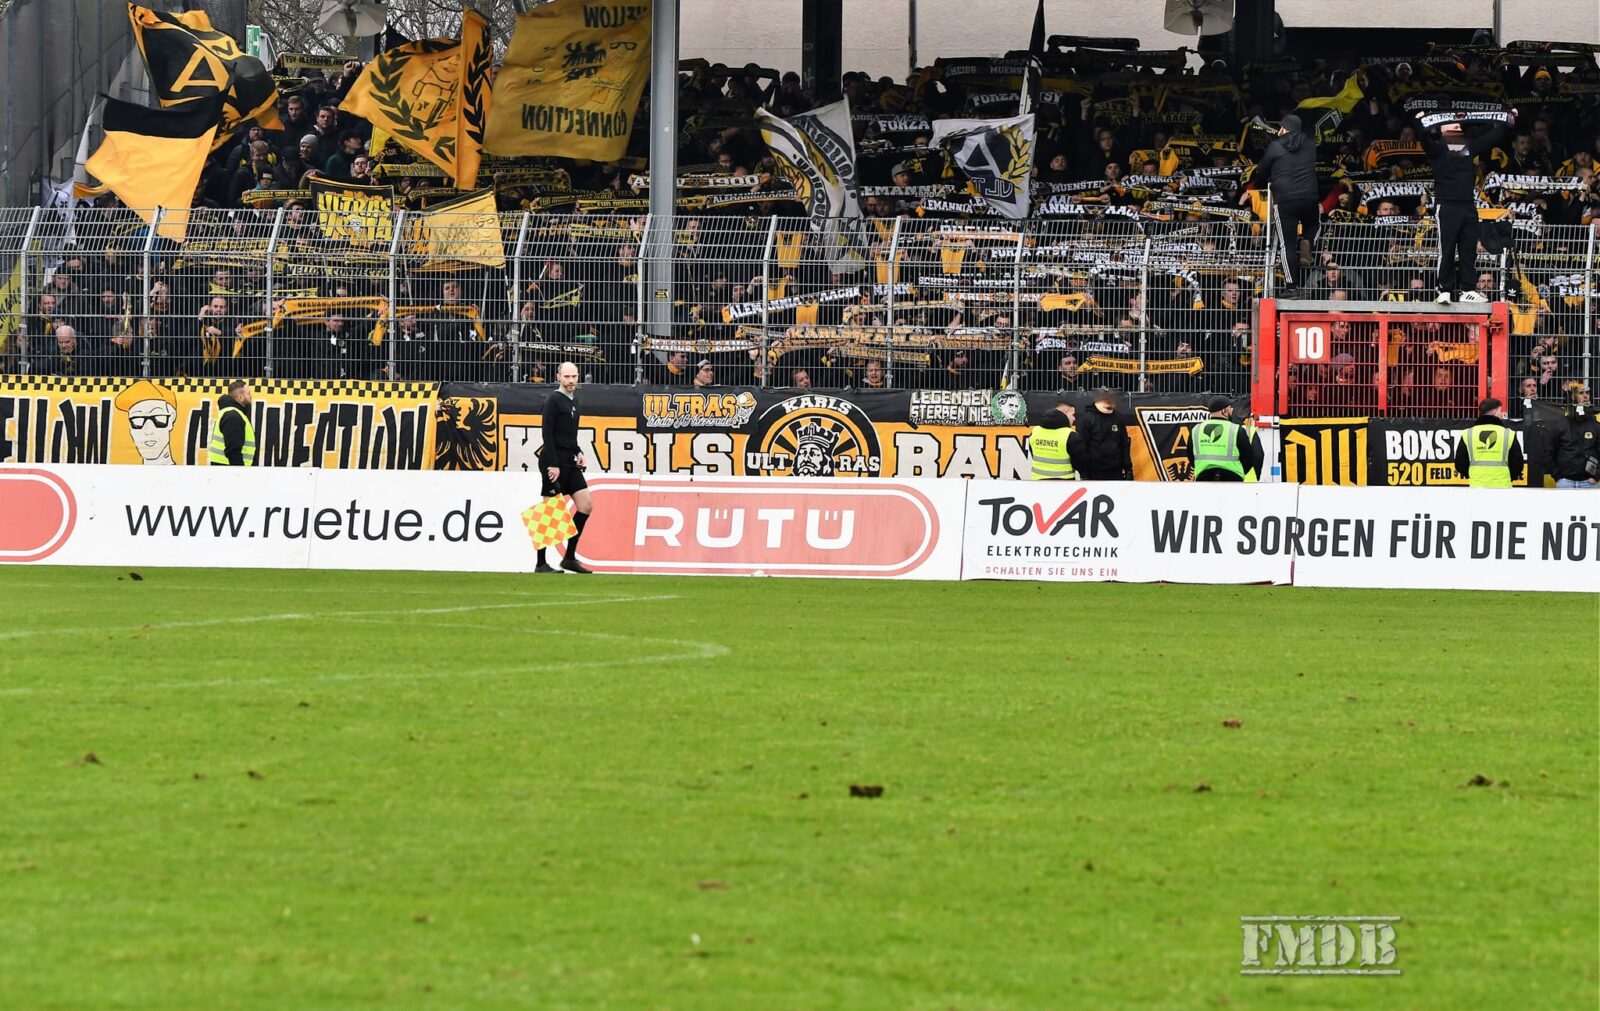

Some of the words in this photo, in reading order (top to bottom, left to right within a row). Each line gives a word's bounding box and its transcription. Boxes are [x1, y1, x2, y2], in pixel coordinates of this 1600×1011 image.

[990, 66, 1024, 75] MUENST
[1451, 101, 1502, 110] MUENSTER
[879, 120, 930, 132] FORZA
[708, 174, 759, 187] 1900
[919, 199, 974, 214] LEMANNIA
[1295, 326, 1324, 360] 10
[644, 394, 738, 418] ULTRAS
[784, 394, 852, 415] KARLS
[910, 389, 991, 405] LEGENDEN
[910, 404, 966, 421] STERBEN
[186, 400, 427, 469] CNNECTION
[1035, 438, 1059, 448] ORDNER
[1385, 429, 1528, 461] BOXSTL
[746, 451, 788, 471] ULT
[838, 453, 880, 473] RAS
[1387, 461, 1424, 486] 520
[1430, 467, 1452, 480] FELD
[125, 499, 504, 542] www.ruetue.de
[635, 506, 855, 549] RÜTÜ
[1236, 515, 1375, 558] SORGEN
[1389, 513, 1457, 560] FÜR
[1470, 520, 1528, 561] DIE
[986, 545, 1119, 559] ELEKTROTECHNIK
[985, 565, 1042, 577] SCHALTEN
[1048, 567, 1066, 577] SIE
[1071, 568, 1094, 578] UNS
[1099, 568, 1118, 578] EIN
